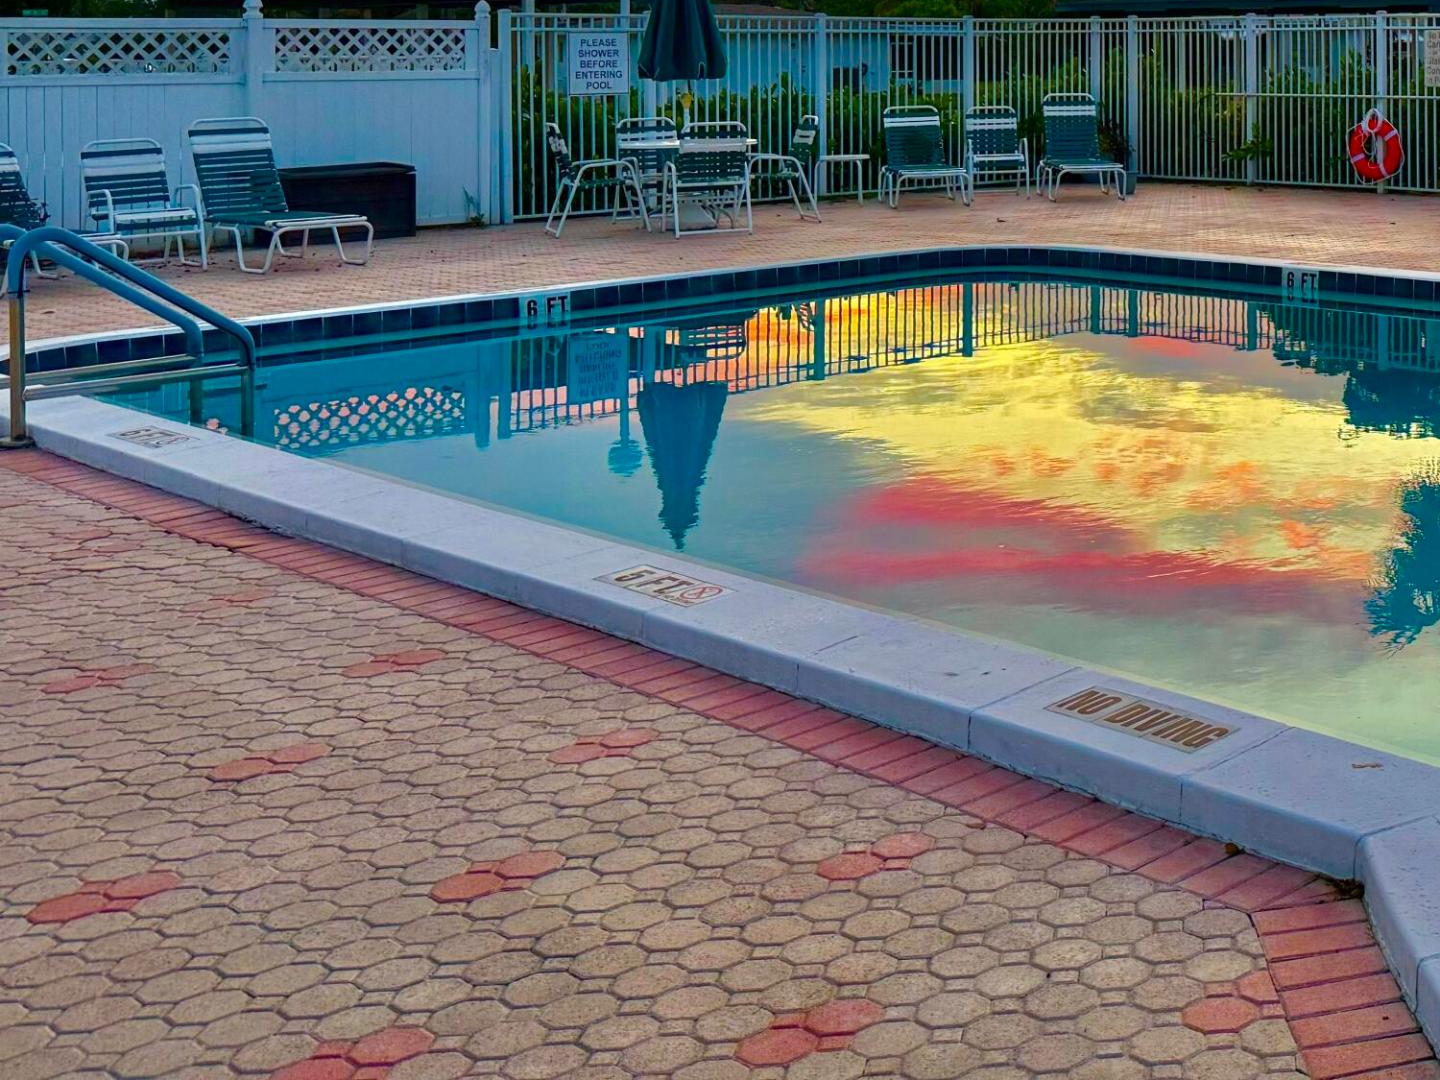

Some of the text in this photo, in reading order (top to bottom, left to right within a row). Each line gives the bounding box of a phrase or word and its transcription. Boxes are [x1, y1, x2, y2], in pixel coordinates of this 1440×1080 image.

[576, 71, 622, 79] ENTERING
[1287, 272, 1294, 287] 6
[527, 299, 537, 316] 6
[614, 569, 656, 582] 5
[1056, 690, 1229, 748] NO DIVING
